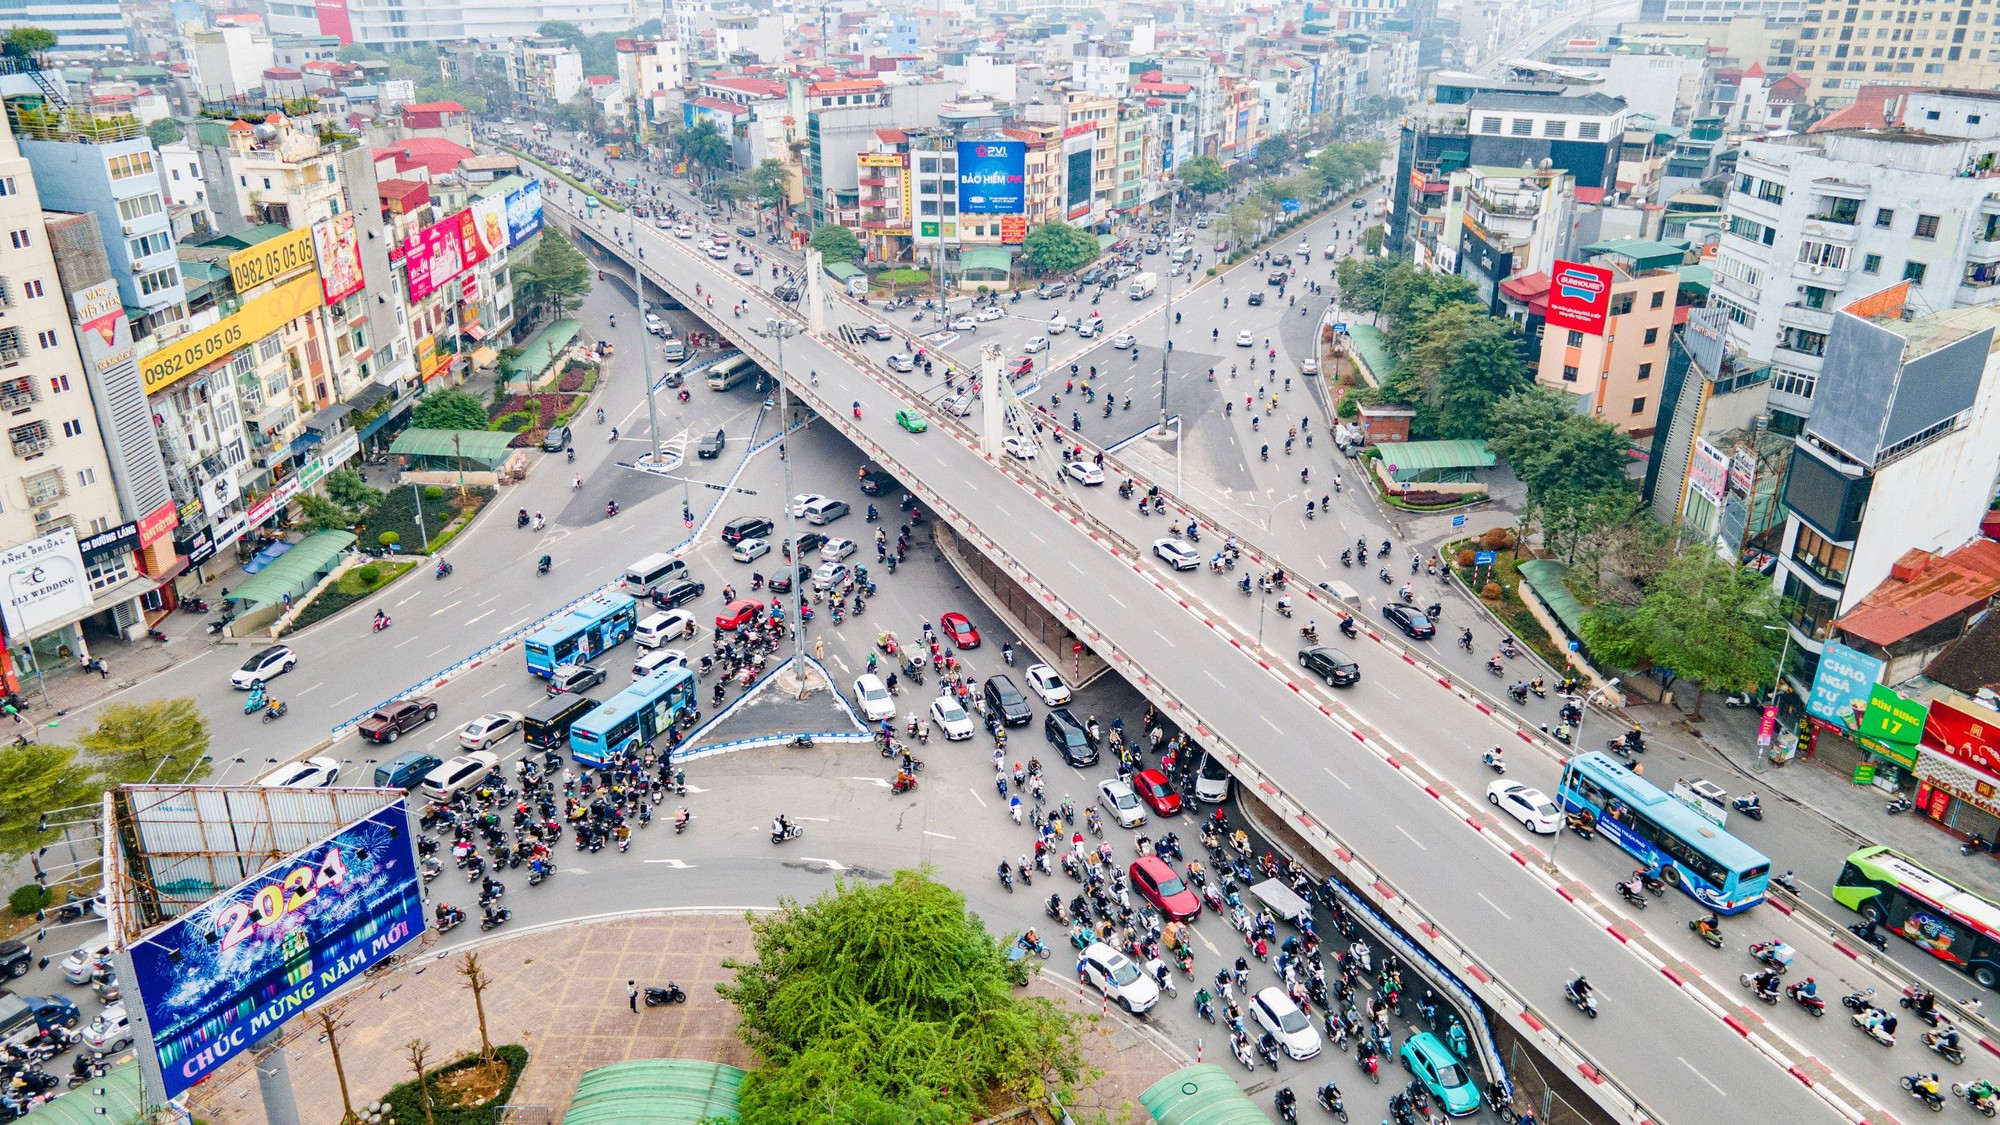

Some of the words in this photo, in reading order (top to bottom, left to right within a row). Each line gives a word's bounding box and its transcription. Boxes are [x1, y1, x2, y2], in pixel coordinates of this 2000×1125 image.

[962, 172, 981, 184] BẢO
[984, 170, 1005, 184] HIỂM
[235, 257, 265, 289] 0982
[266, 250, 280, 276] 05
[283, 244, 297, 268] 05
[299, 237, 312, 262] 05
[1561, 276, 1600, 290] SUNHOUSE
[145, 354, 183, 386] 0982
[185, 344, 203, 365] 05
[205, 334, 223, 354] 05
[225, 325, 242, 344] 05
[117, 525, 136, 539] LÁNG
[31, 539, 65, 555] BRIDAL
[31, 577, 75, 598] WEDDING
[1824, 659, 1867, 685] CHÀO,
[1817, 686, 1840, 701] TƯ
[1812, 701, 1834, 717] SỞ
[1871, 697, 1892, 712] BÚN
[1892, 706, 1920, 726] BUNG
[1881, 718, 1902, 734] 17
[217, 847, 348, 951] 2024
[182, 1026, 245, 1078] CHÚC
[251, 982, 316, 1035] MỪNG
[321, 952, 367, 989] NĂM
[371, 920, 410, 956] MỚI
